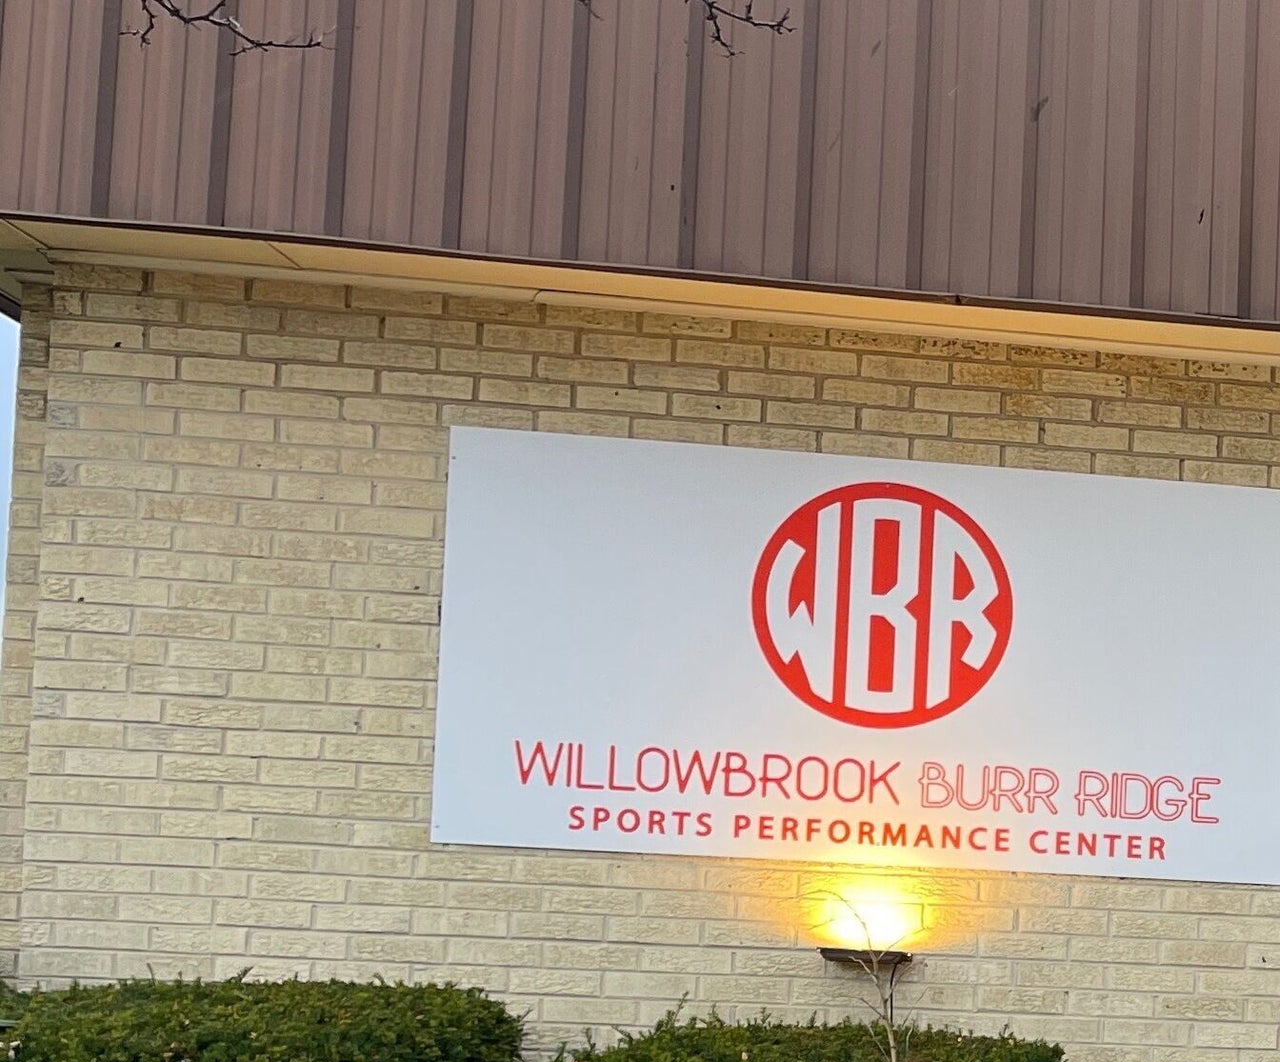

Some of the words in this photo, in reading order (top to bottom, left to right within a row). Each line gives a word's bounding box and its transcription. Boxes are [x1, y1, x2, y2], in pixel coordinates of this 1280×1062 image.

[763, 497, 1001, 715] WBR
[514, 740, 902, 806] WILLOWBROOK
[917, 761, 1060, 815] BURR
[1074, 770, 1222, 825] RIDGE
[568, 805, 713, 837] SPORTS
[733, 814, 1011, 853] PERFORMANCE
[1028, 829, 1167, 861] CENTER
